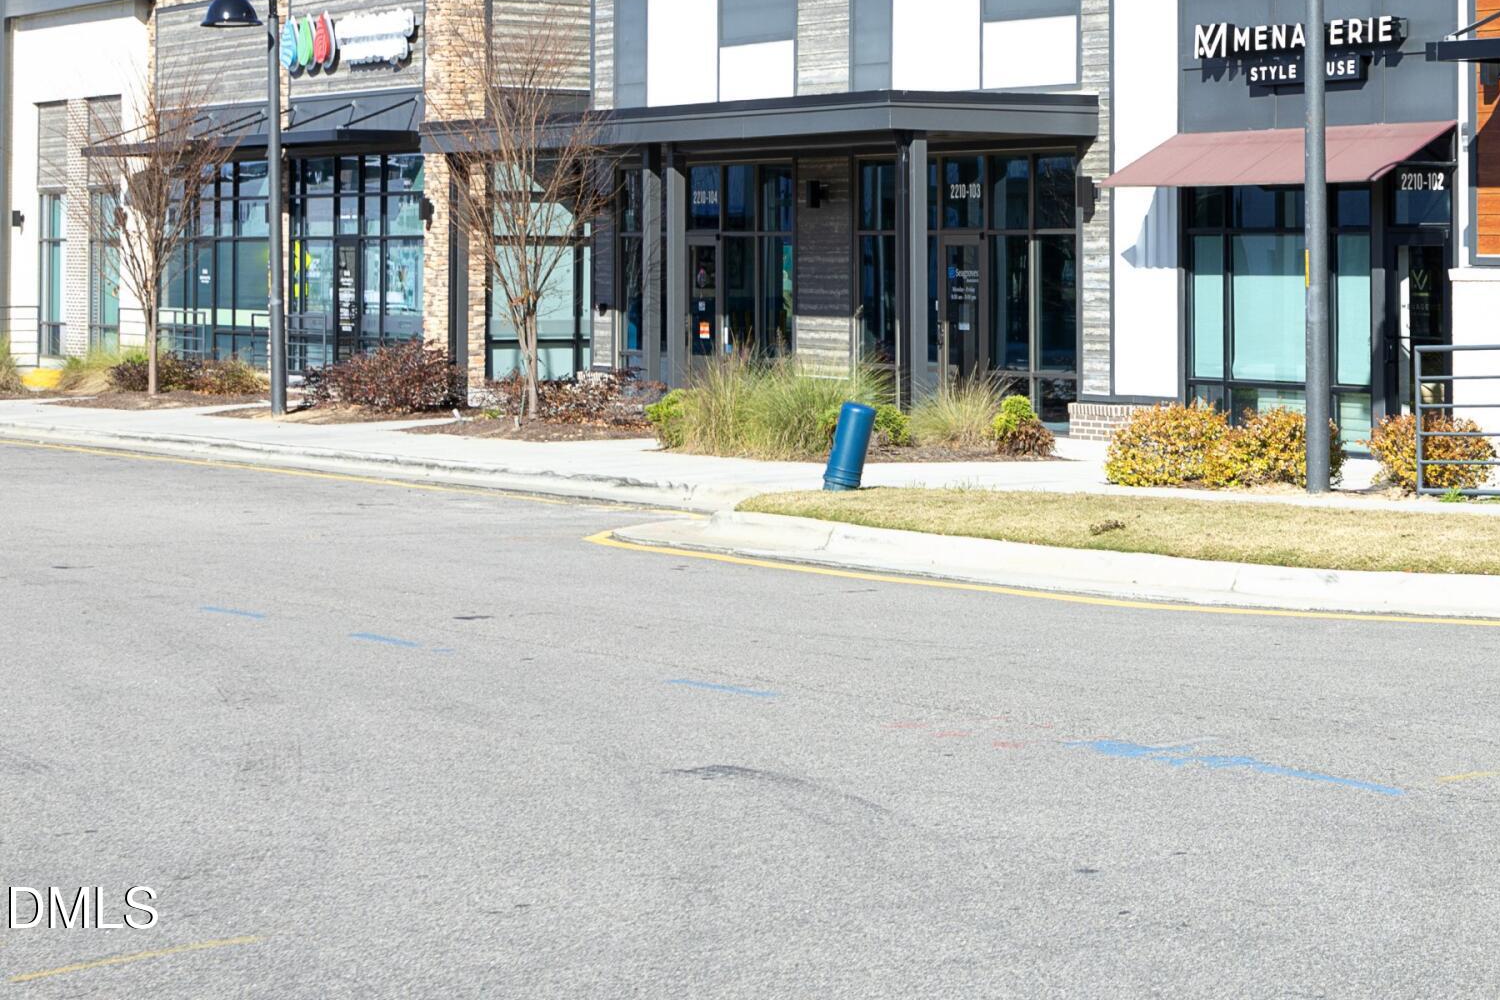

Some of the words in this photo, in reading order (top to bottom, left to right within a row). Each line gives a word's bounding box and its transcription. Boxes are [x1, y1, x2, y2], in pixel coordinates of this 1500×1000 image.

[1233, 15, 1393, 52] MENAERIE
[1250, 64, 1297, 82] STYLE
[1322, 59, 1356, 76] USE
[950, 183, 981, 199] 2210-103
[1401, 172, 1445, 191] 2210-102
[692, 190, 718, 204] 2210-104
